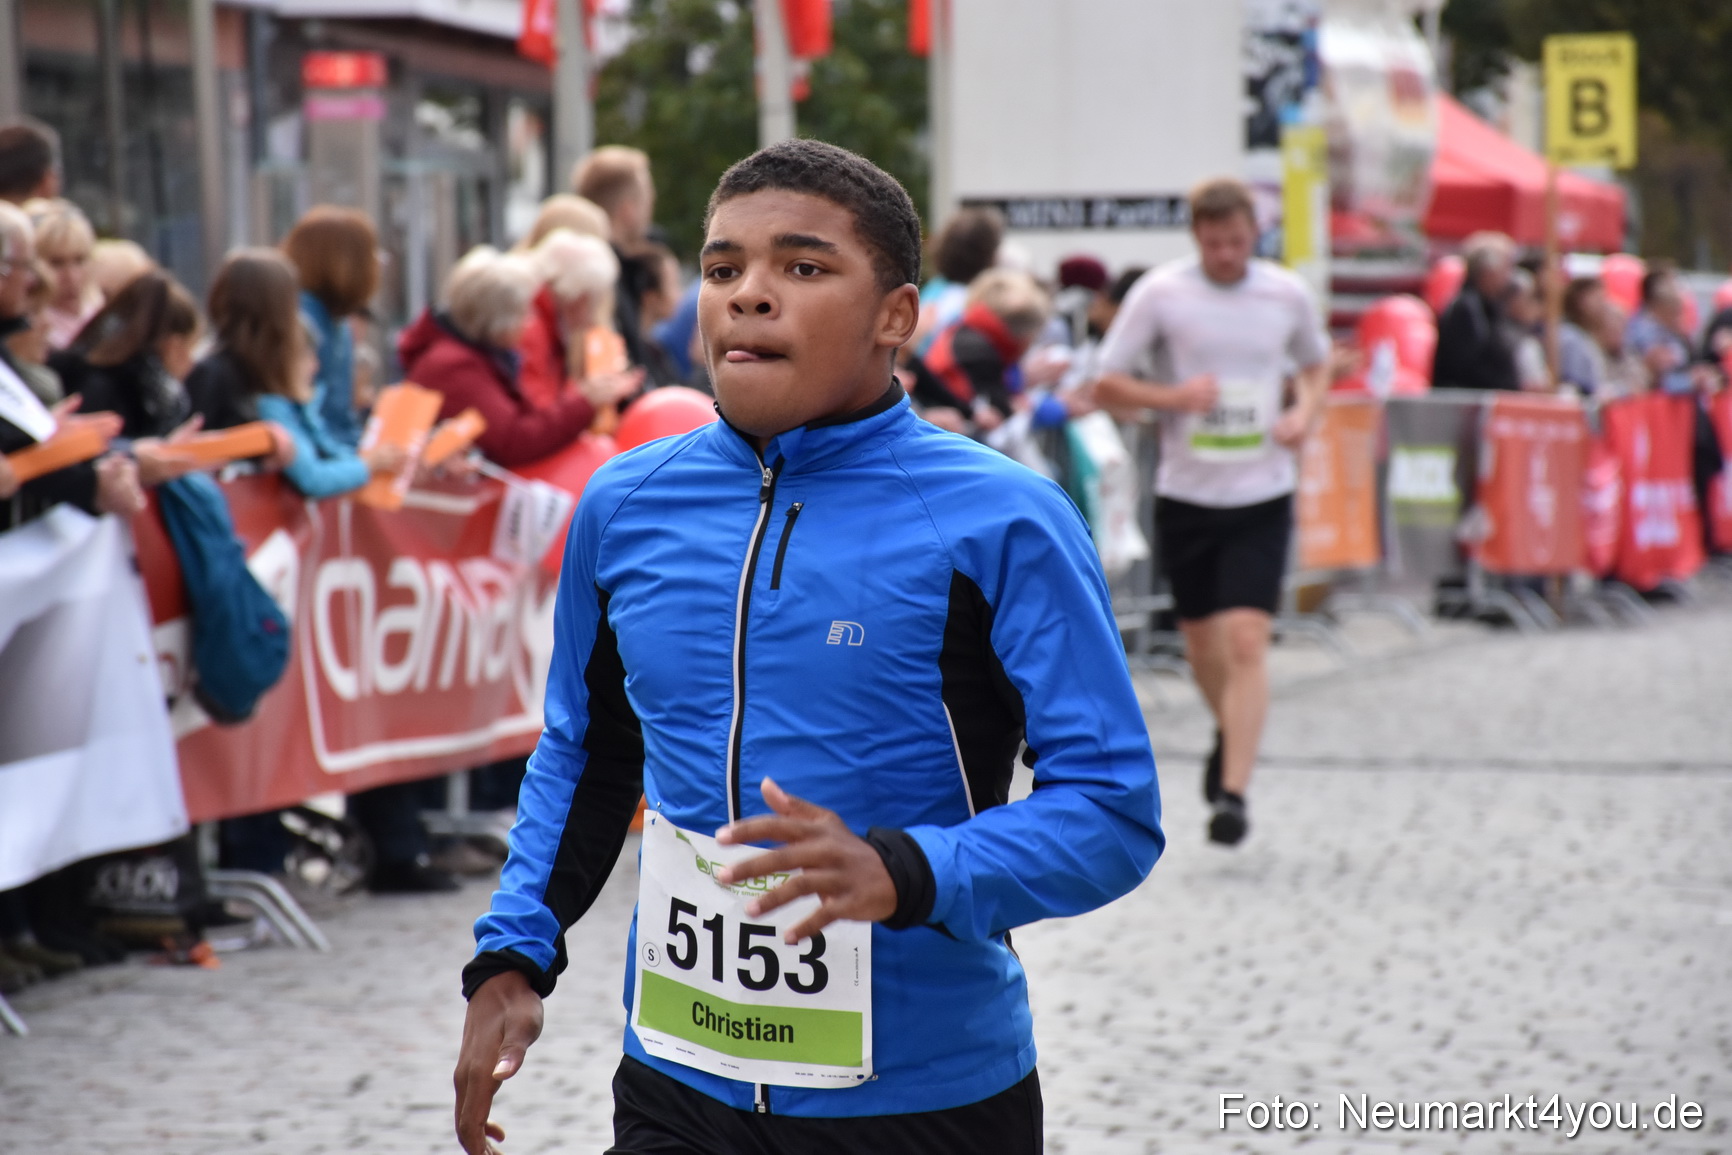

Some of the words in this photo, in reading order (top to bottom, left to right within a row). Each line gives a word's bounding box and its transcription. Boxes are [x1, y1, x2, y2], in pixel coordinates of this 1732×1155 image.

[1569, 78, 1611, 137] B
[648, 948, 655, 962] S
[666, 896, 829, 995] 5153
[691, 1000, 795, 1044] Christian
